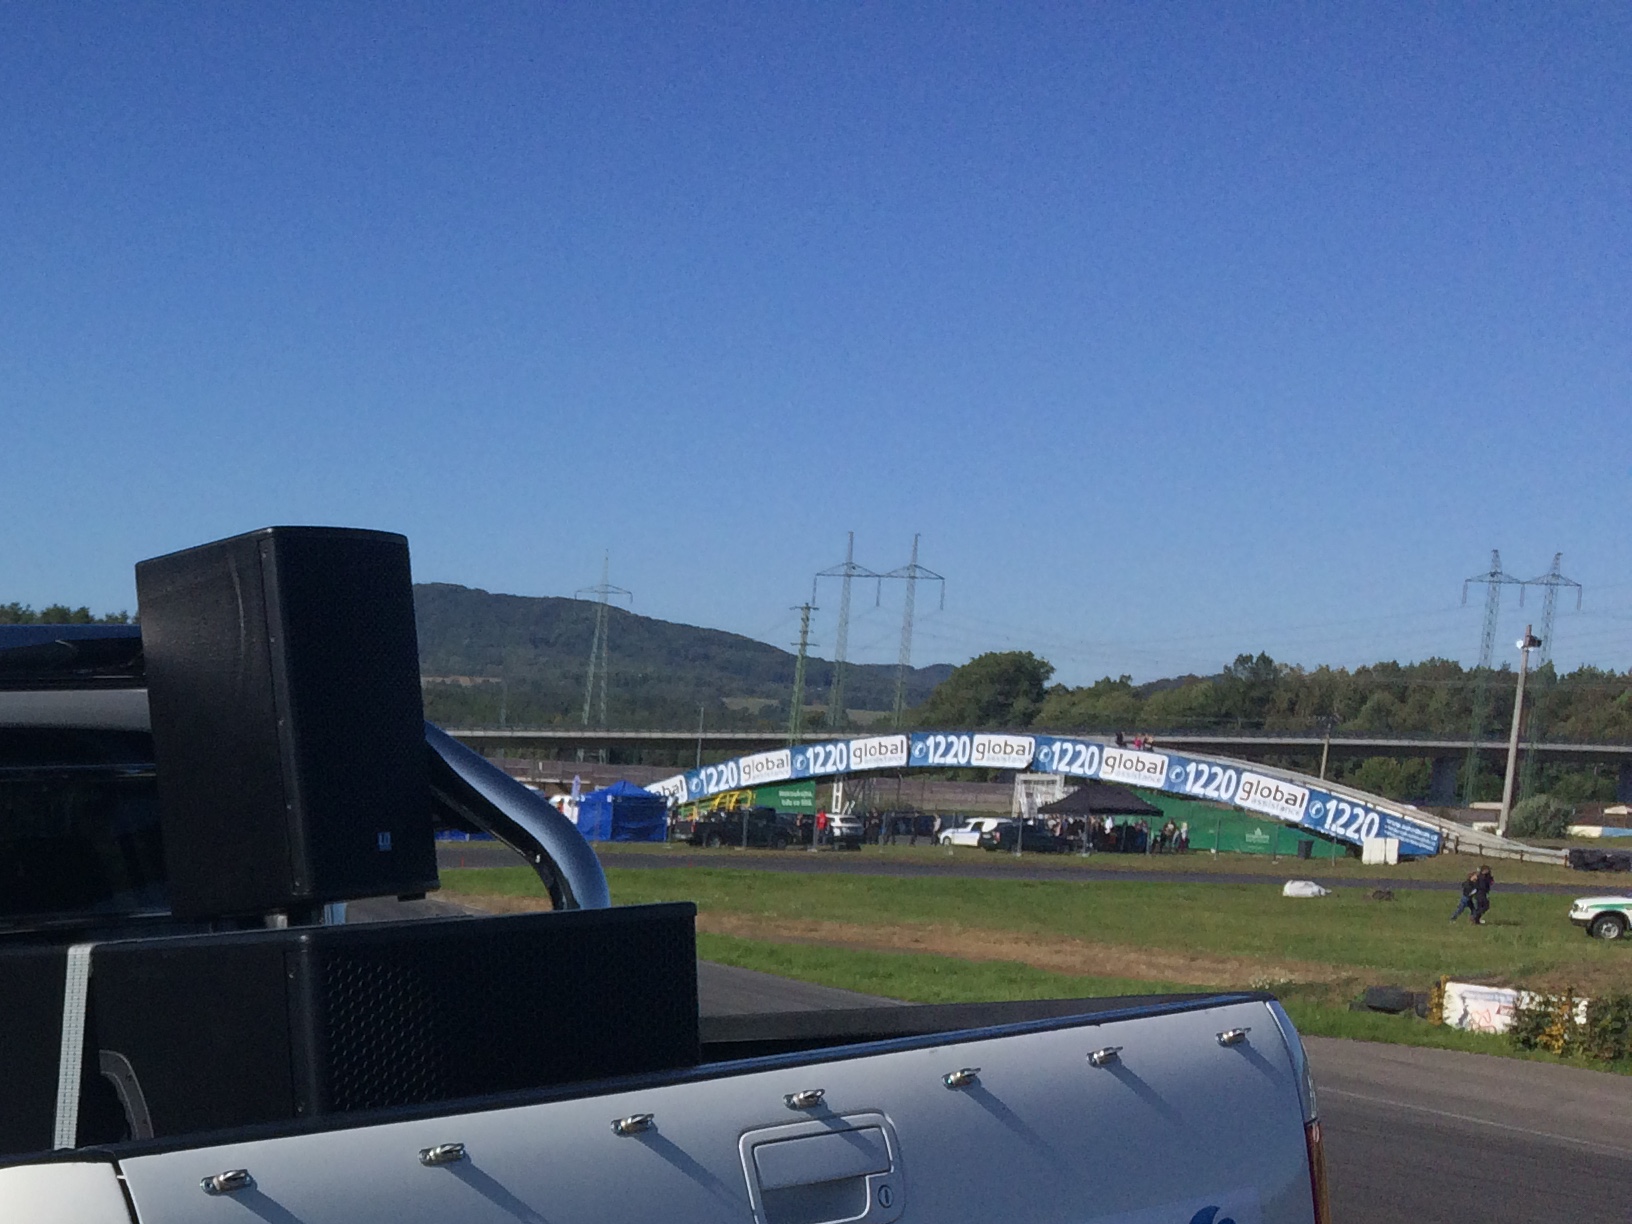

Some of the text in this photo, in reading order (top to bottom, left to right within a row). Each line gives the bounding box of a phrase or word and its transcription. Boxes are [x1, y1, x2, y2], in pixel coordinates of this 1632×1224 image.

[805, 741, 847, 775] 1220
[852, 739, 904, 766] global
[926, 735, 970, 766] 1220
[974, 739, 1033, 762] global
[1051, 741, 1100, 776] 1220
[1102, 753, 1165, 776] global
[699, 762, 738, 796] 1220
[742, 753, 789, 782] global
[1184, 761, 1237, 800] 1220
[1239, 780, 1306, 809] global
[1323, 798, 1380, 842] 1220
